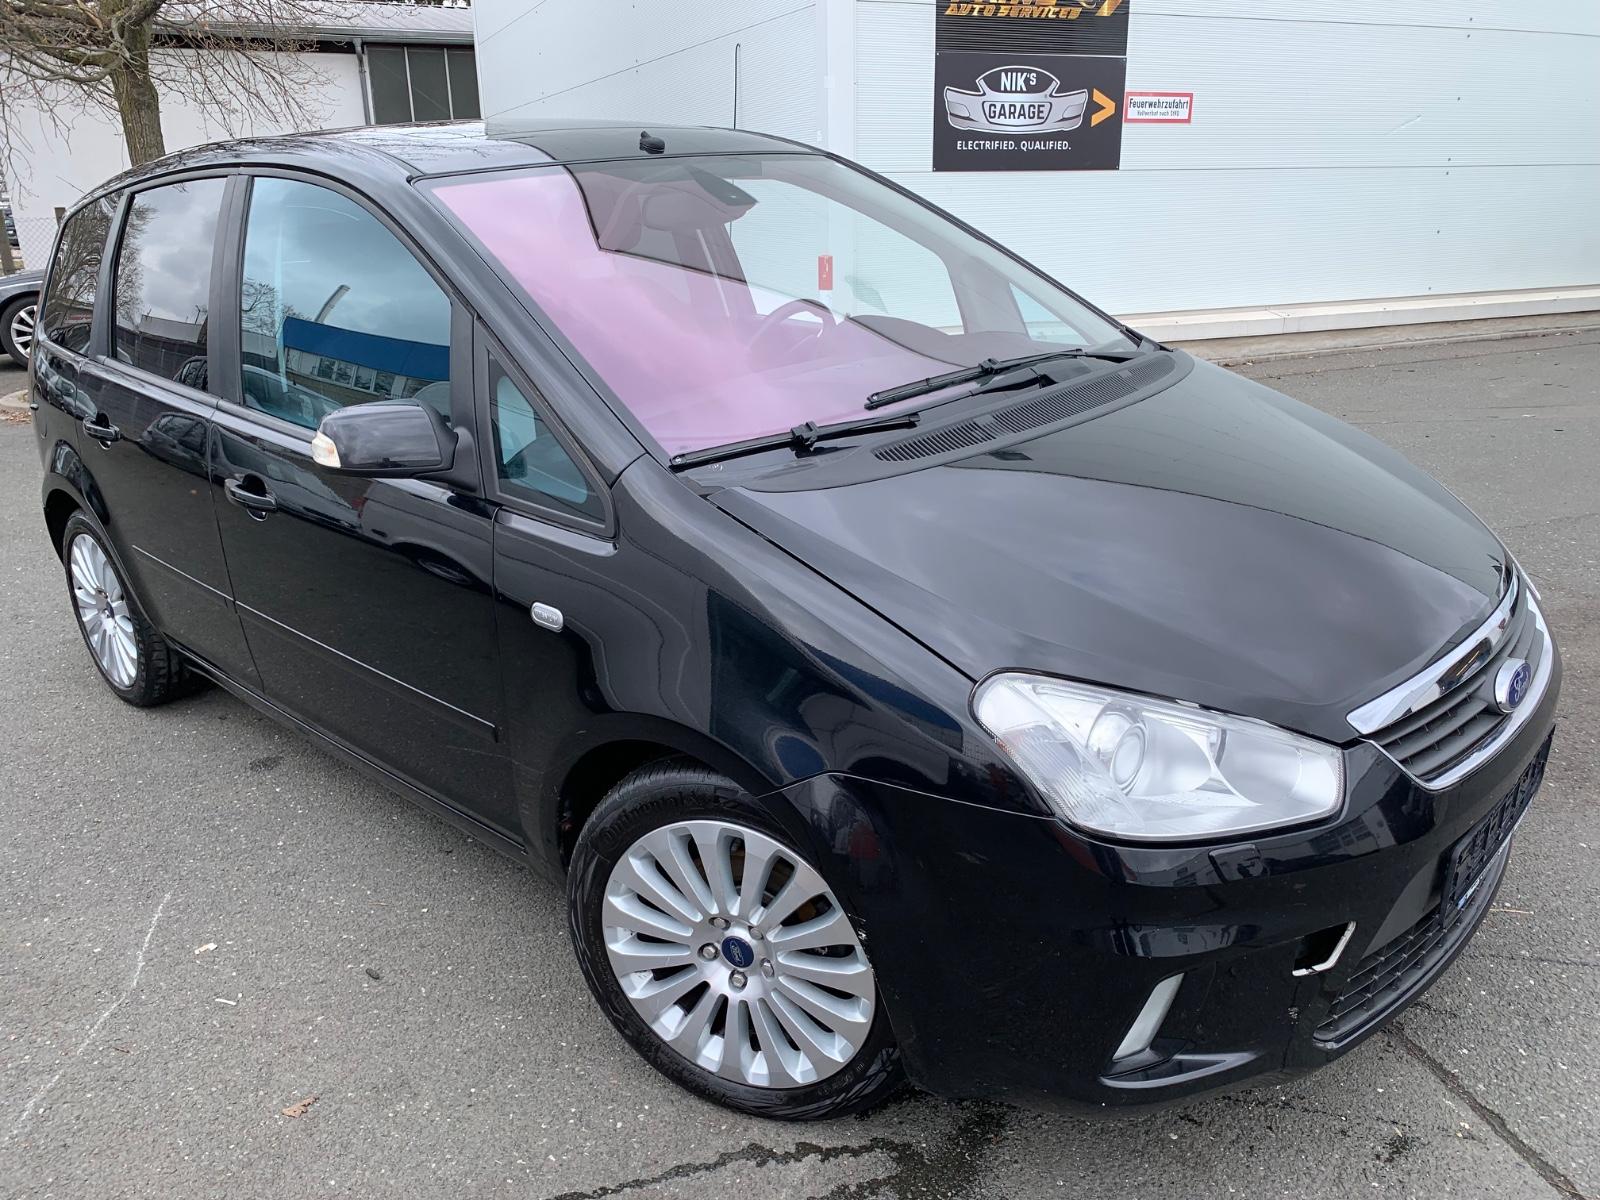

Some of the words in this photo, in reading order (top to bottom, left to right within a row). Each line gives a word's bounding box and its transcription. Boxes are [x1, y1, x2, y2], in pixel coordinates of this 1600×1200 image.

[944, 4, 996, 16] AUTO
[997, 5, 1082, 20] SERVICES
[1129, 98, 1188, 109] Feuerwehrzufahrt
[988, 103, 1045, 120] GARAGE
[957, 140, 1017, 151] ELECTRIFIED.
[1020, 140, 1071, 151] QUALIFIED.
